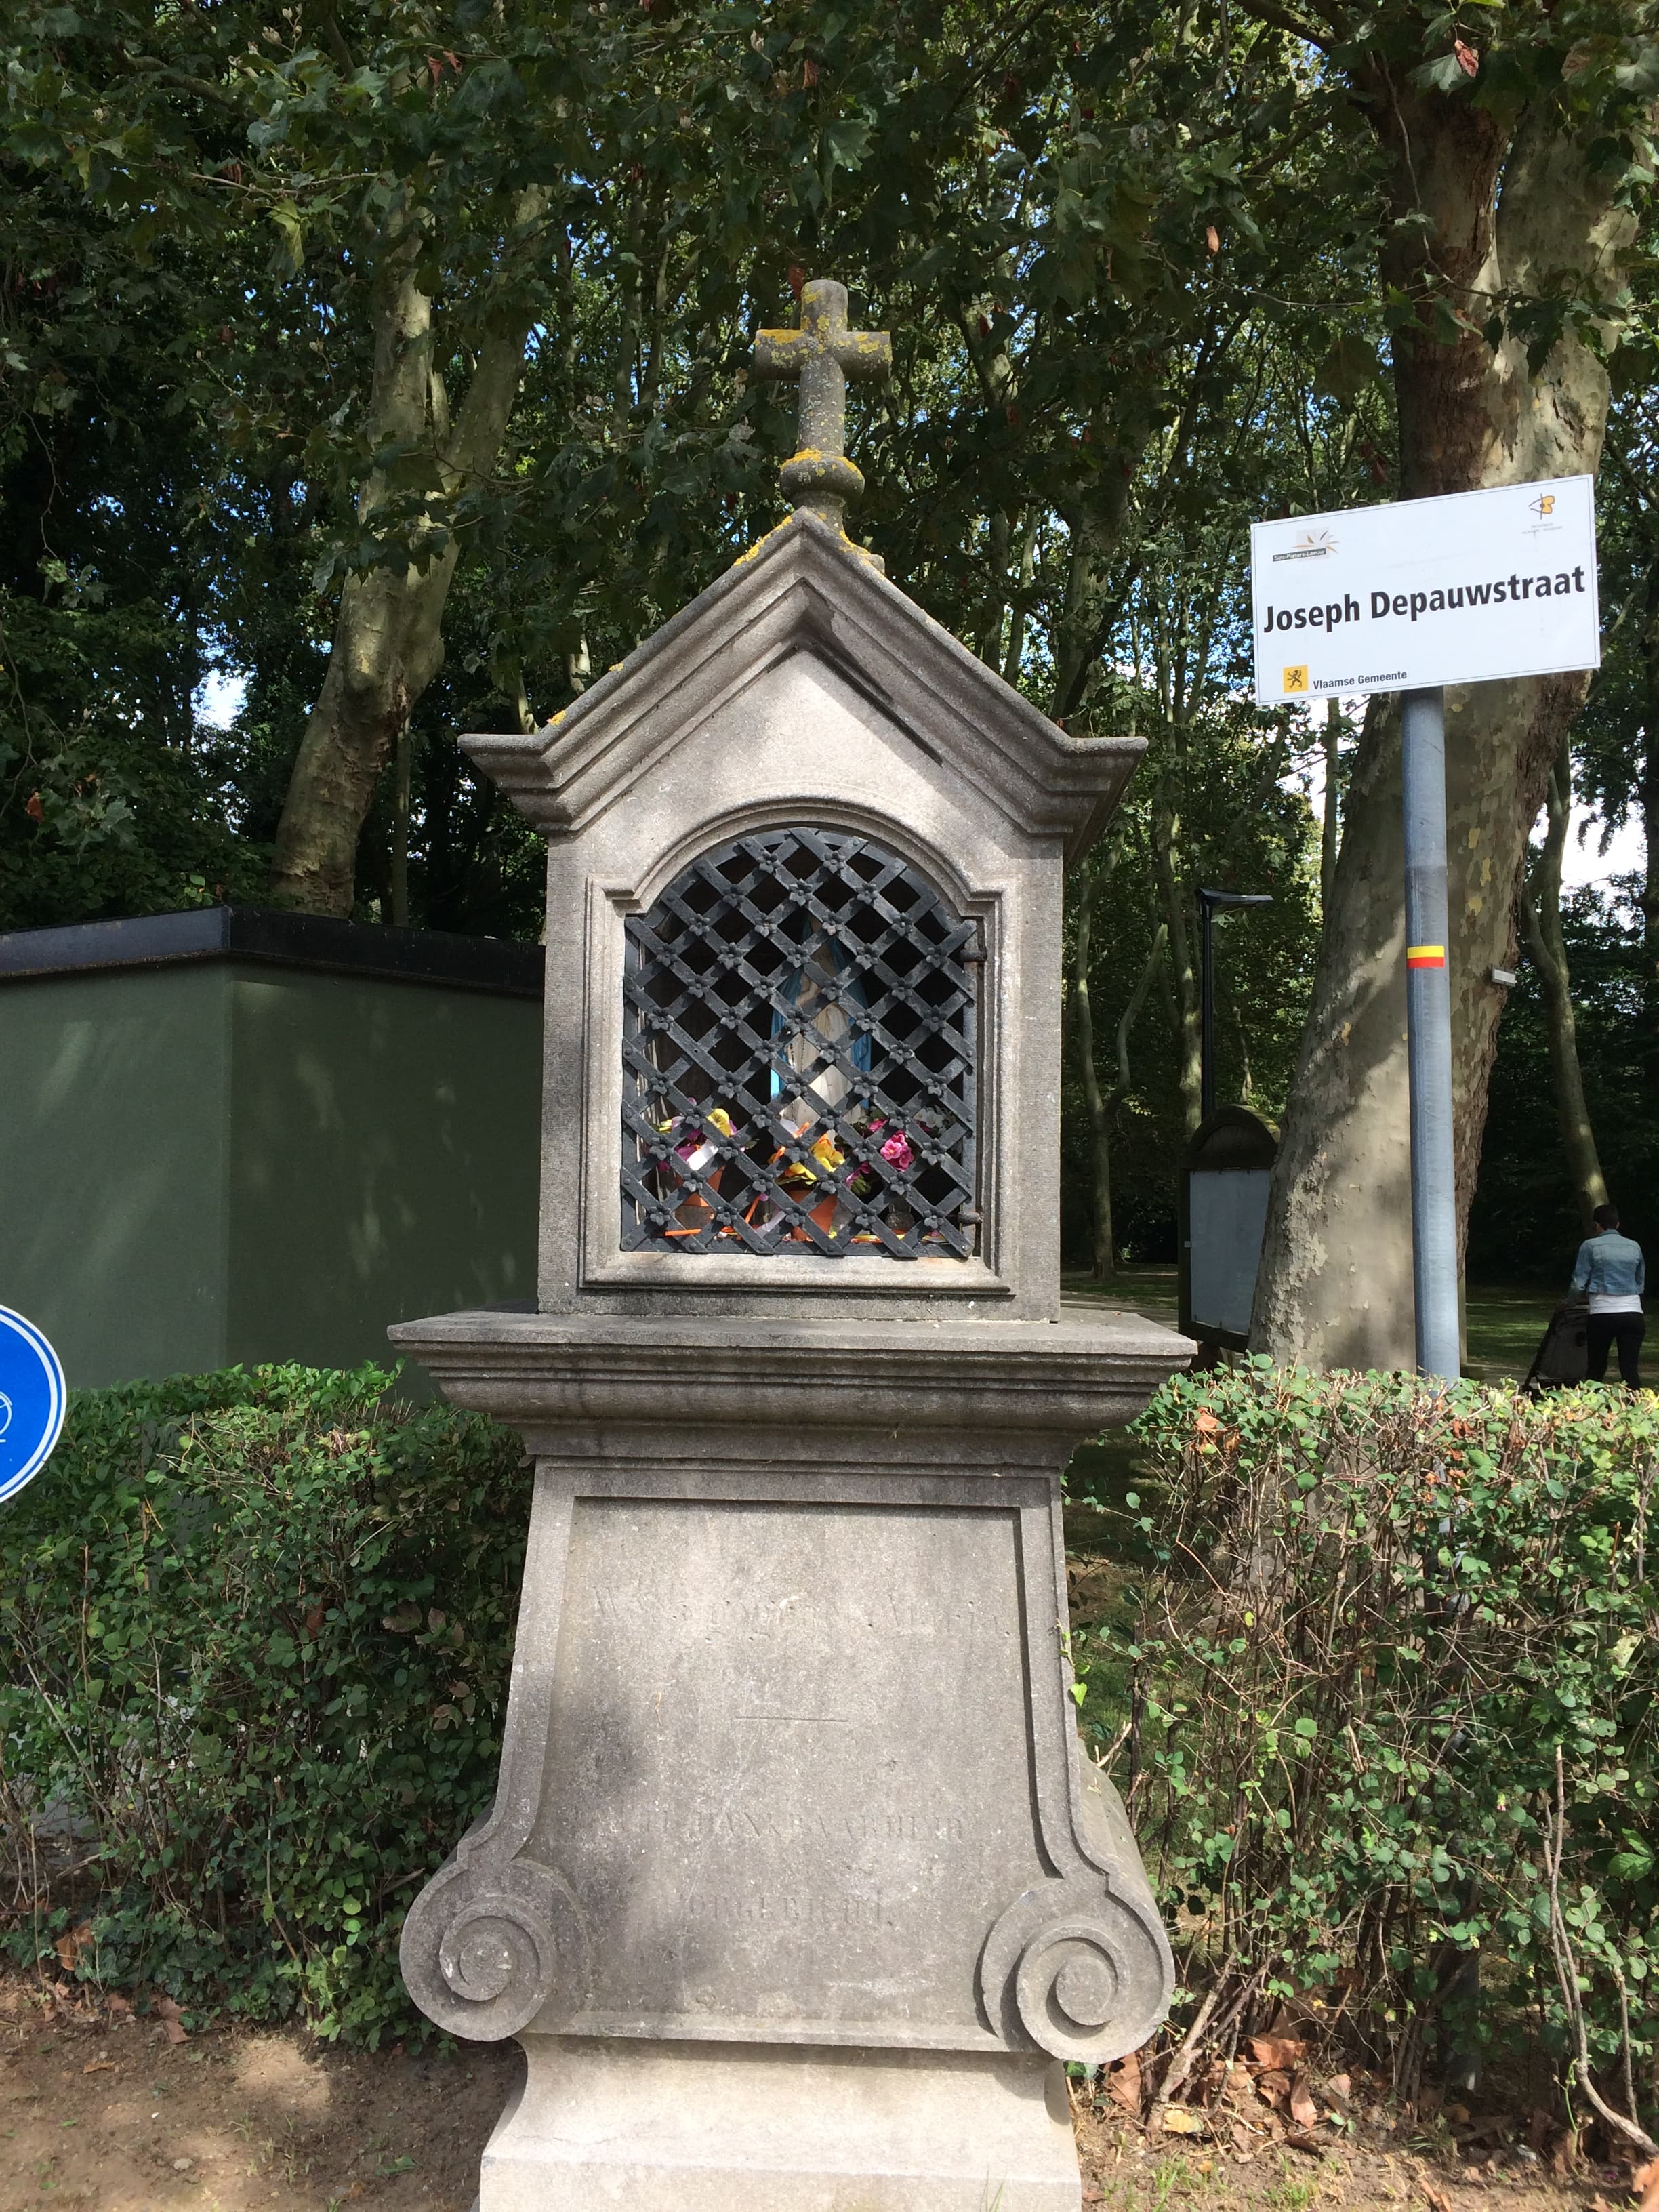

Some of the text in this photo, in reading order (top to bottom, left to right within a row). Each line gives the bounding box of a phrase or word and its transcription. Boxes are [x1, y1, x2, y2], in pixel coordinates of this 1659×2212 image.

[1263, 566, 1585, 632] Joseph Depauwstraat
[1313, 671, 1408, 689] Vlaamse Gemeente
